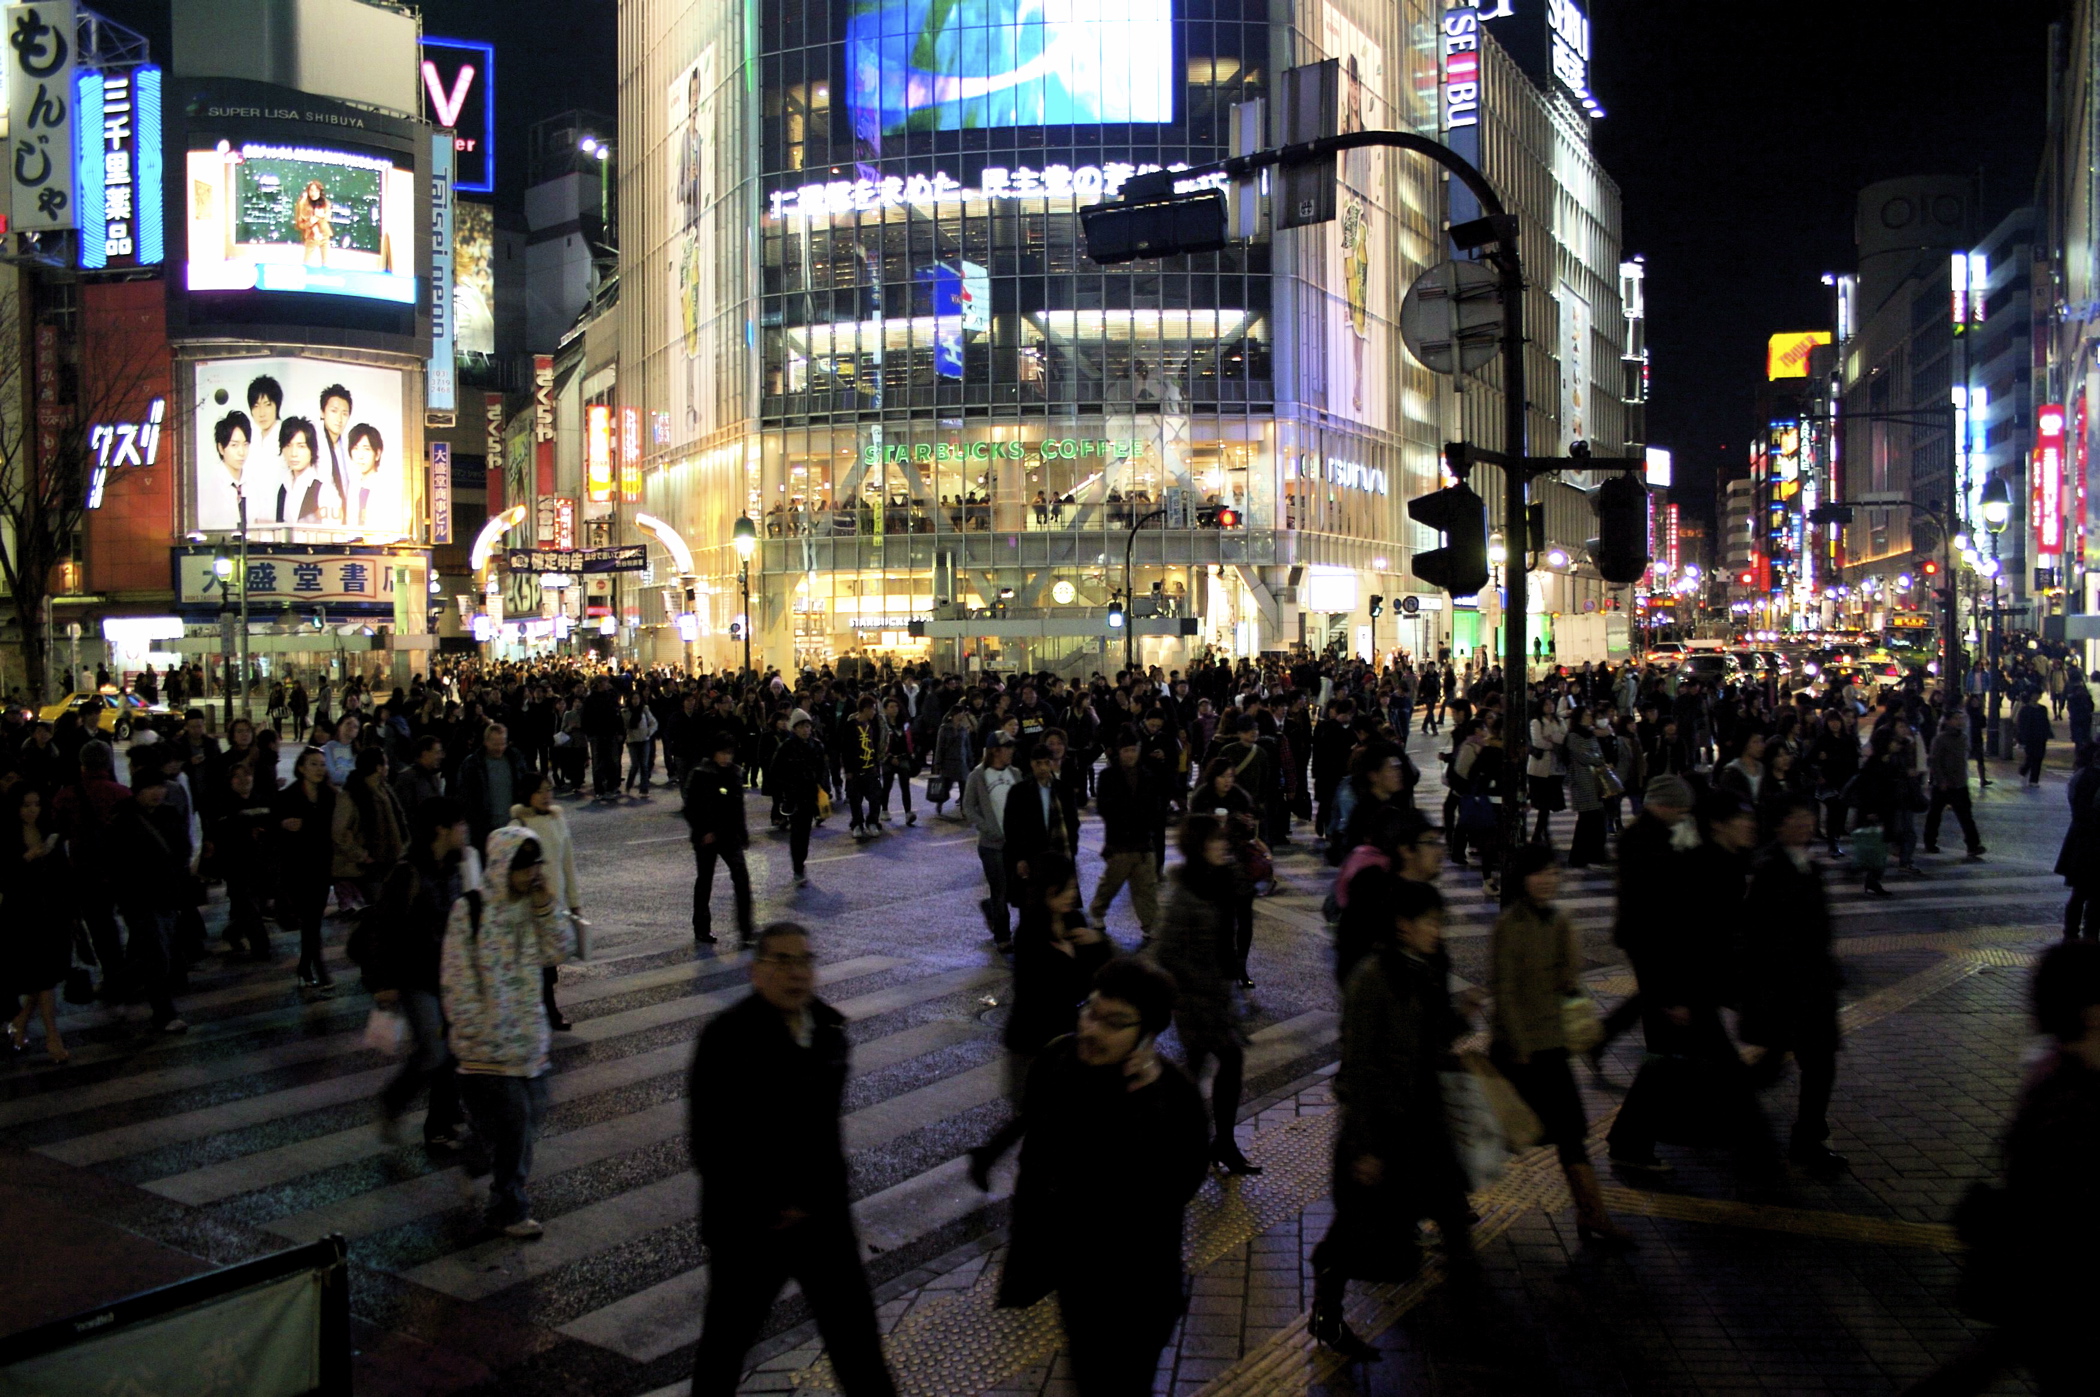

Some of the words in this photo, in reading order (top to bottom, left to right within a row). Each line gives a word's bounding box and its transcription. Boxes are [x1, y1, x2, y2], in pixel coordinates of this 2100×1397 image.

[1445, 15, 1478, 129] SEIBU
[11, 8, 68, 221] もんじゃ
[209, 106, 260, 118] SUPER
[265, 107, 299, 120] LISA
[305, 111, 365, 129] SHIBUYA
[104, 78, 132, 257] 三千里薬品
[432, 168, 448, 256] Taisei
[432, 269, 445, 338] neon
[486, 403, 503, 469] さくらや
[536, 367, 554, 442] さくらや
[89, 399, 165, 509] クスリ
[864, 440, 1025, 466] STARBUCKS
[1040, 437, 1144, 460] COFFEE
[434, 449, 447, 536] 大盛堂商事ビル
[848, 616, 912, 628] STARBUCKS
